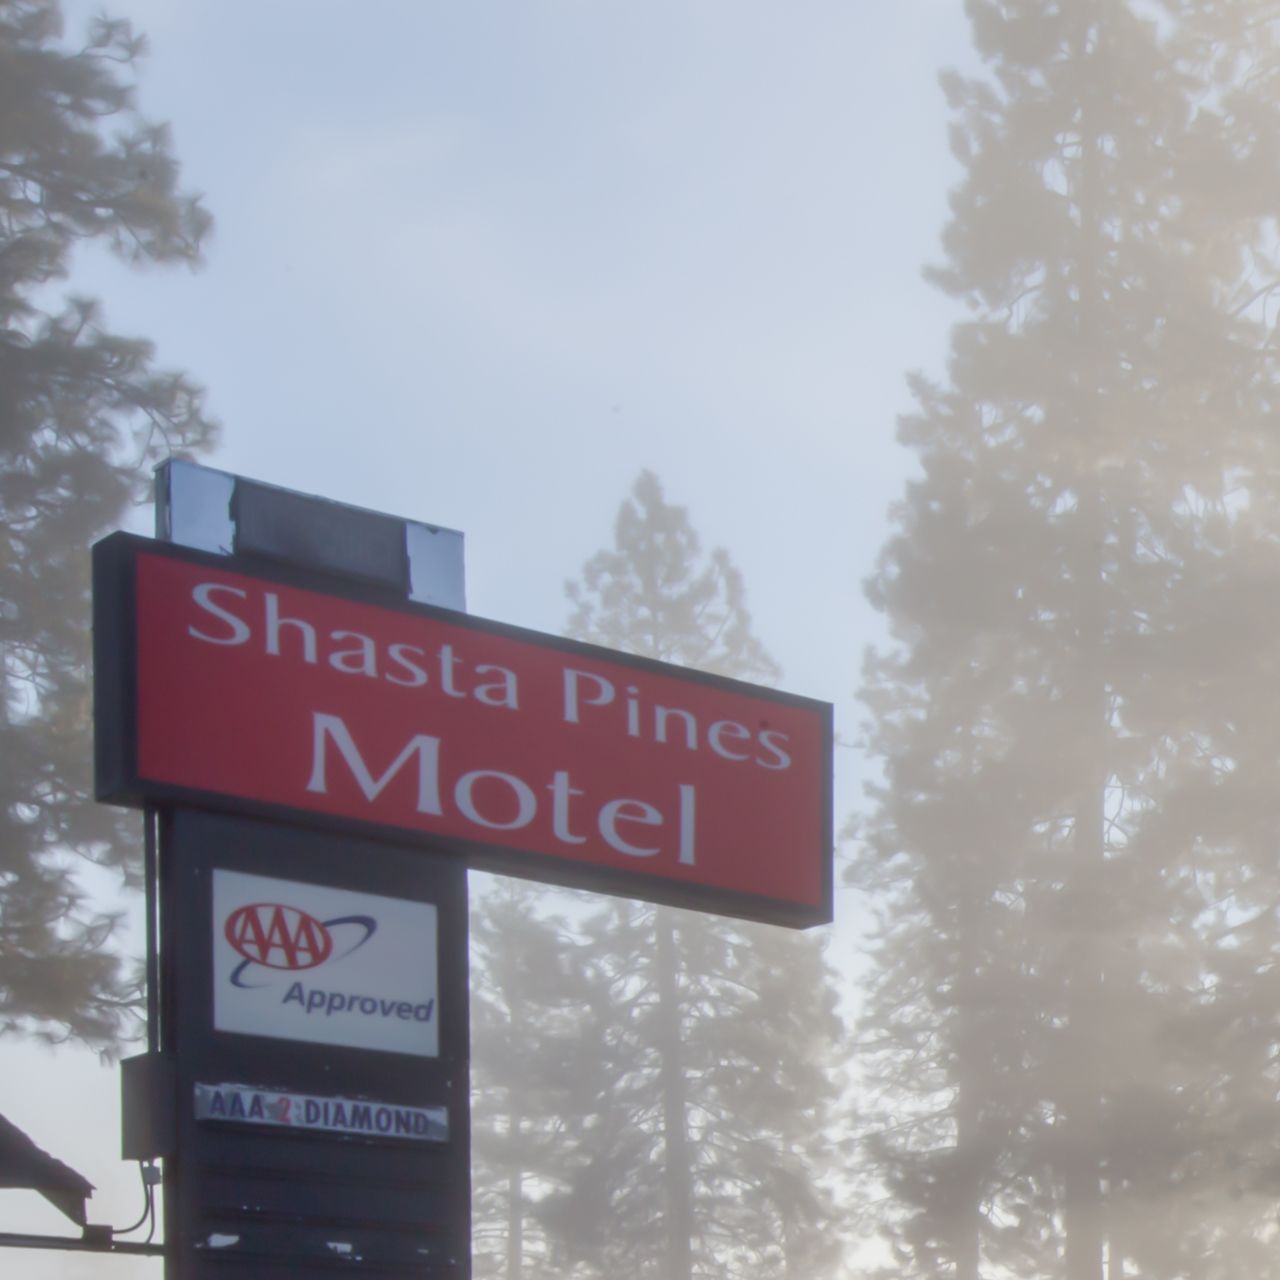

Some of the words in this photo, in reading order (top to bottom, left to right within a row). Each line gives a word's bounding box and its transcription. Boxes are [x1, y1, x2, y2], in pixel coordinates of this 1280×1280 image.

[187, 581, 520, 711] Shasta
[563, 667, 793, 771] Pines
[305, 711, 697, 867] Motel
[233, 904, 323, 969] AAA
[282, 981, 434, 1022] Approved
[209, 1090, 265, 1119] AAA
[278, 1096, 291, 1123] 2
[304, 1099, 430, 1135] DIAMOND
